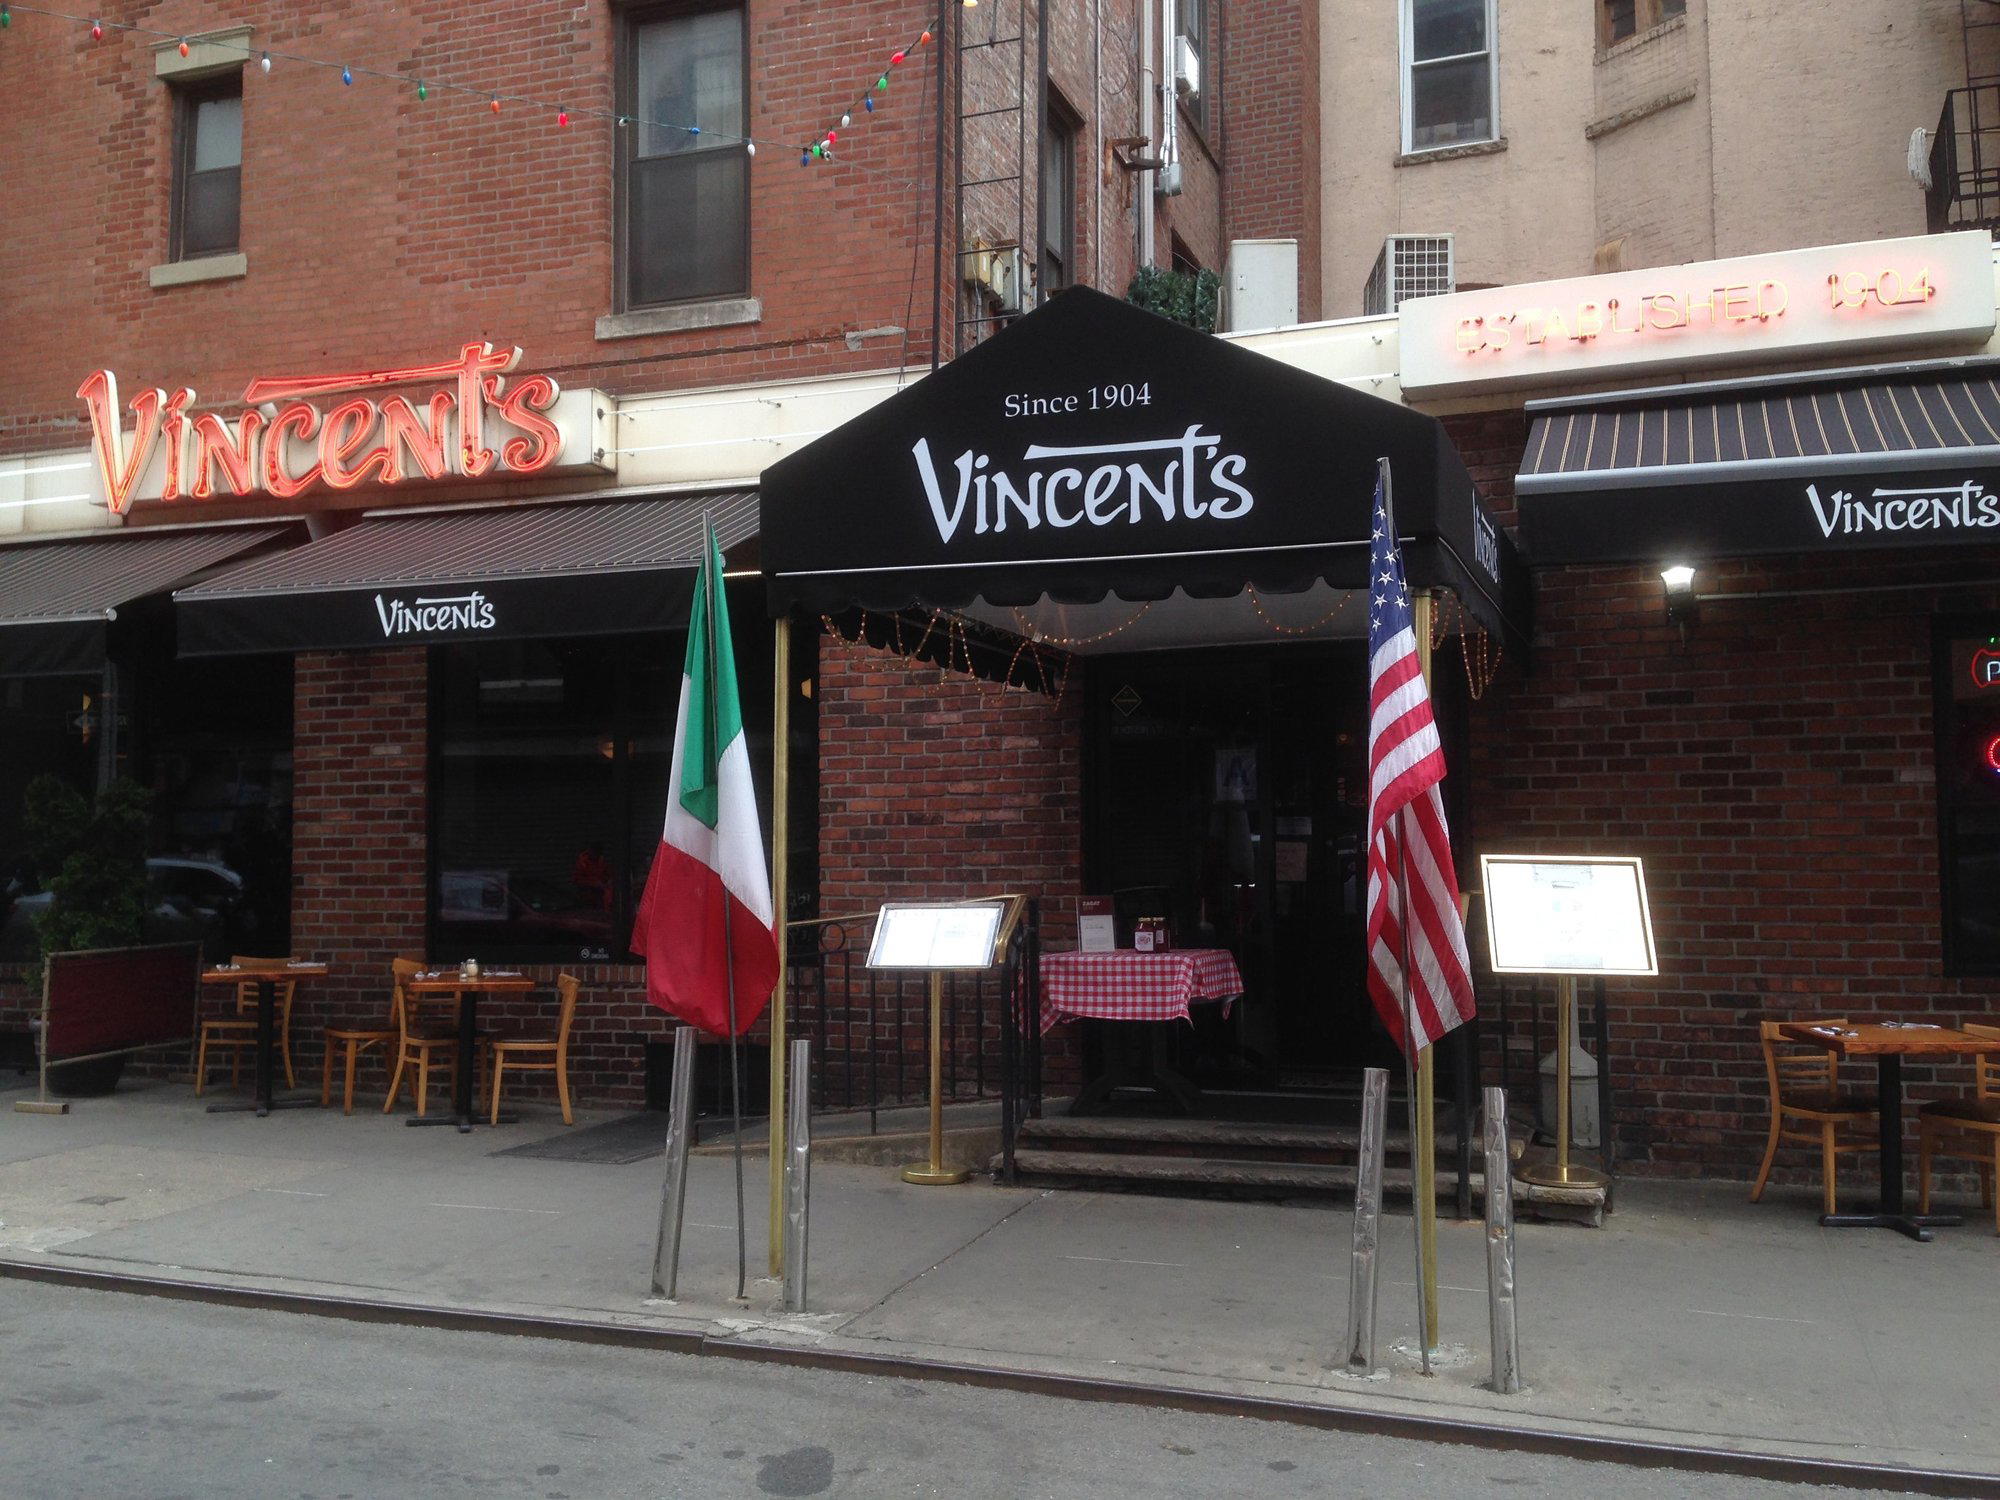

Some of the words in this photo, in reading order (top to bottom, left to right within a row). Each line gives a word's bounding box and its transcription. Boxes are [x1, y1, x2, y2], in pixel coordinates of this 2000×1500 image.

[1455, 279, 1790, 352] ESTABLISHED
[1827, 266, 1935, 308] 1904
[76, 341, 560, 514] Vincent's
[1004, 393, 1078, 418] Since
[1087, 382, 1151, 410] 1904
[912, 424, 1254, 544] Vincent's
[374, 590, 496, 637] Vincent's
